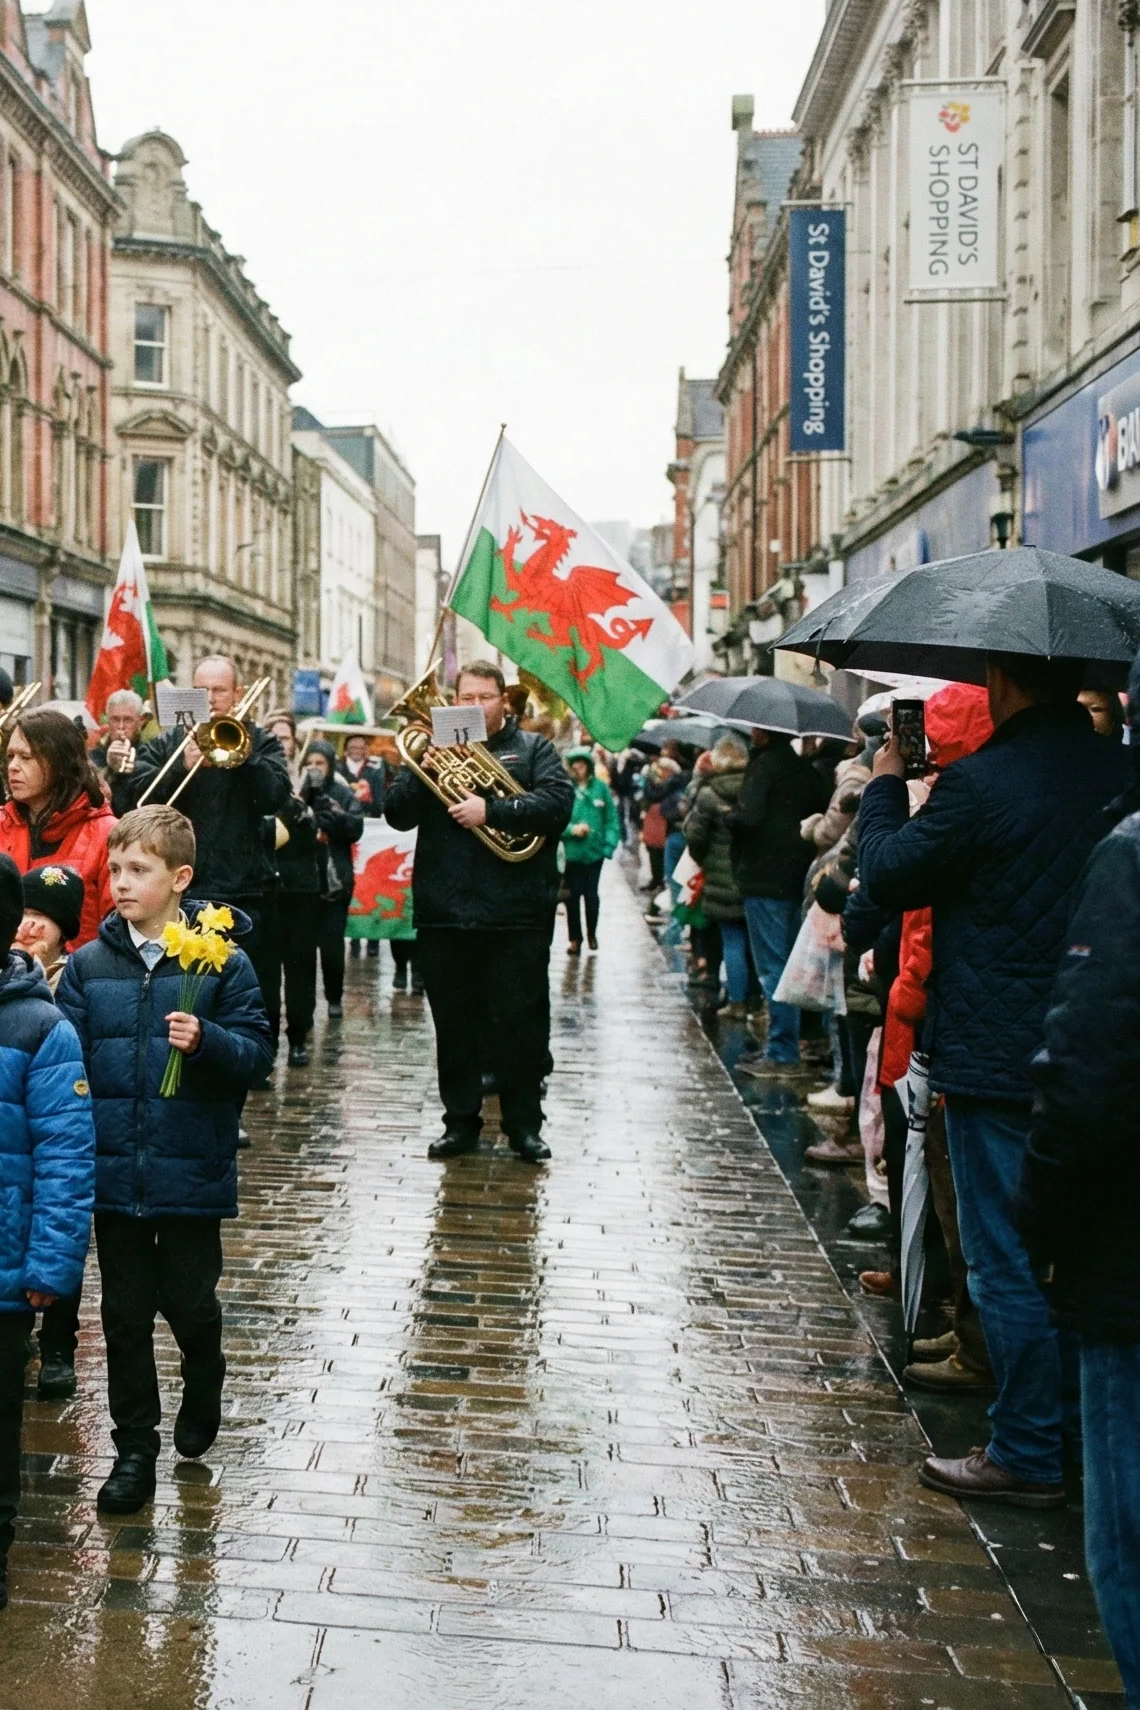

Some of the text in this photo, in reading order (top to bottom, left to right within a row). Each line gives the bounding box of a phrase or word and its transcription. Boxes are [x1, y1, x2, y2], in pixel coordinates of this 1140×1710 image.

[928, 144, 951, 276] SHOPPING
[957, 142, 979, 266] ST DAVID'S
[802, 223, 832, 435] St David's Shopping
